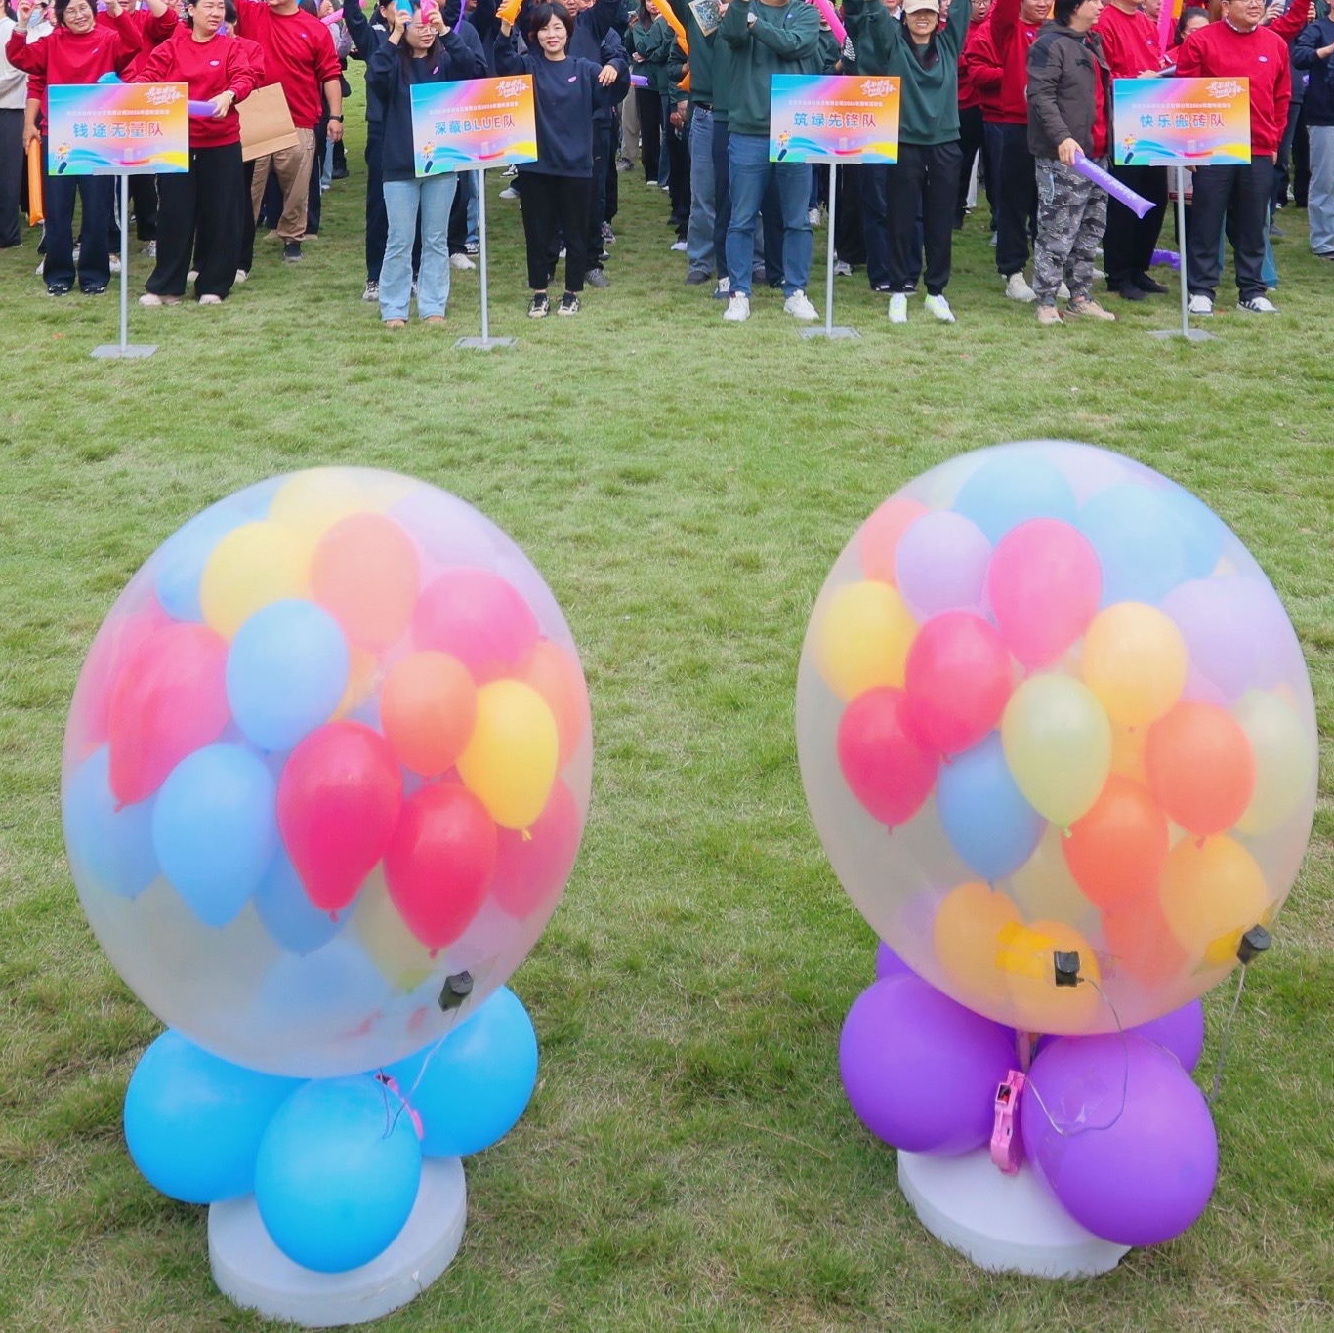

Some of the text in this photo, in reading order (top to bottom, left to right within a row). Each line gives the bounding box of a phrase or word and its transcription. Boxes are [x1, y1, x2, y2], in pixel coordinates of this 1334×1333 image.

[435, 114, 516, 136] 深藏BLUE队
[793, 112, 876, 127] 筑绿先锋队
[1140, 113, 1225, 128] 快乐搬砖队
[73, 122, 163, 137] 钱途无量队
